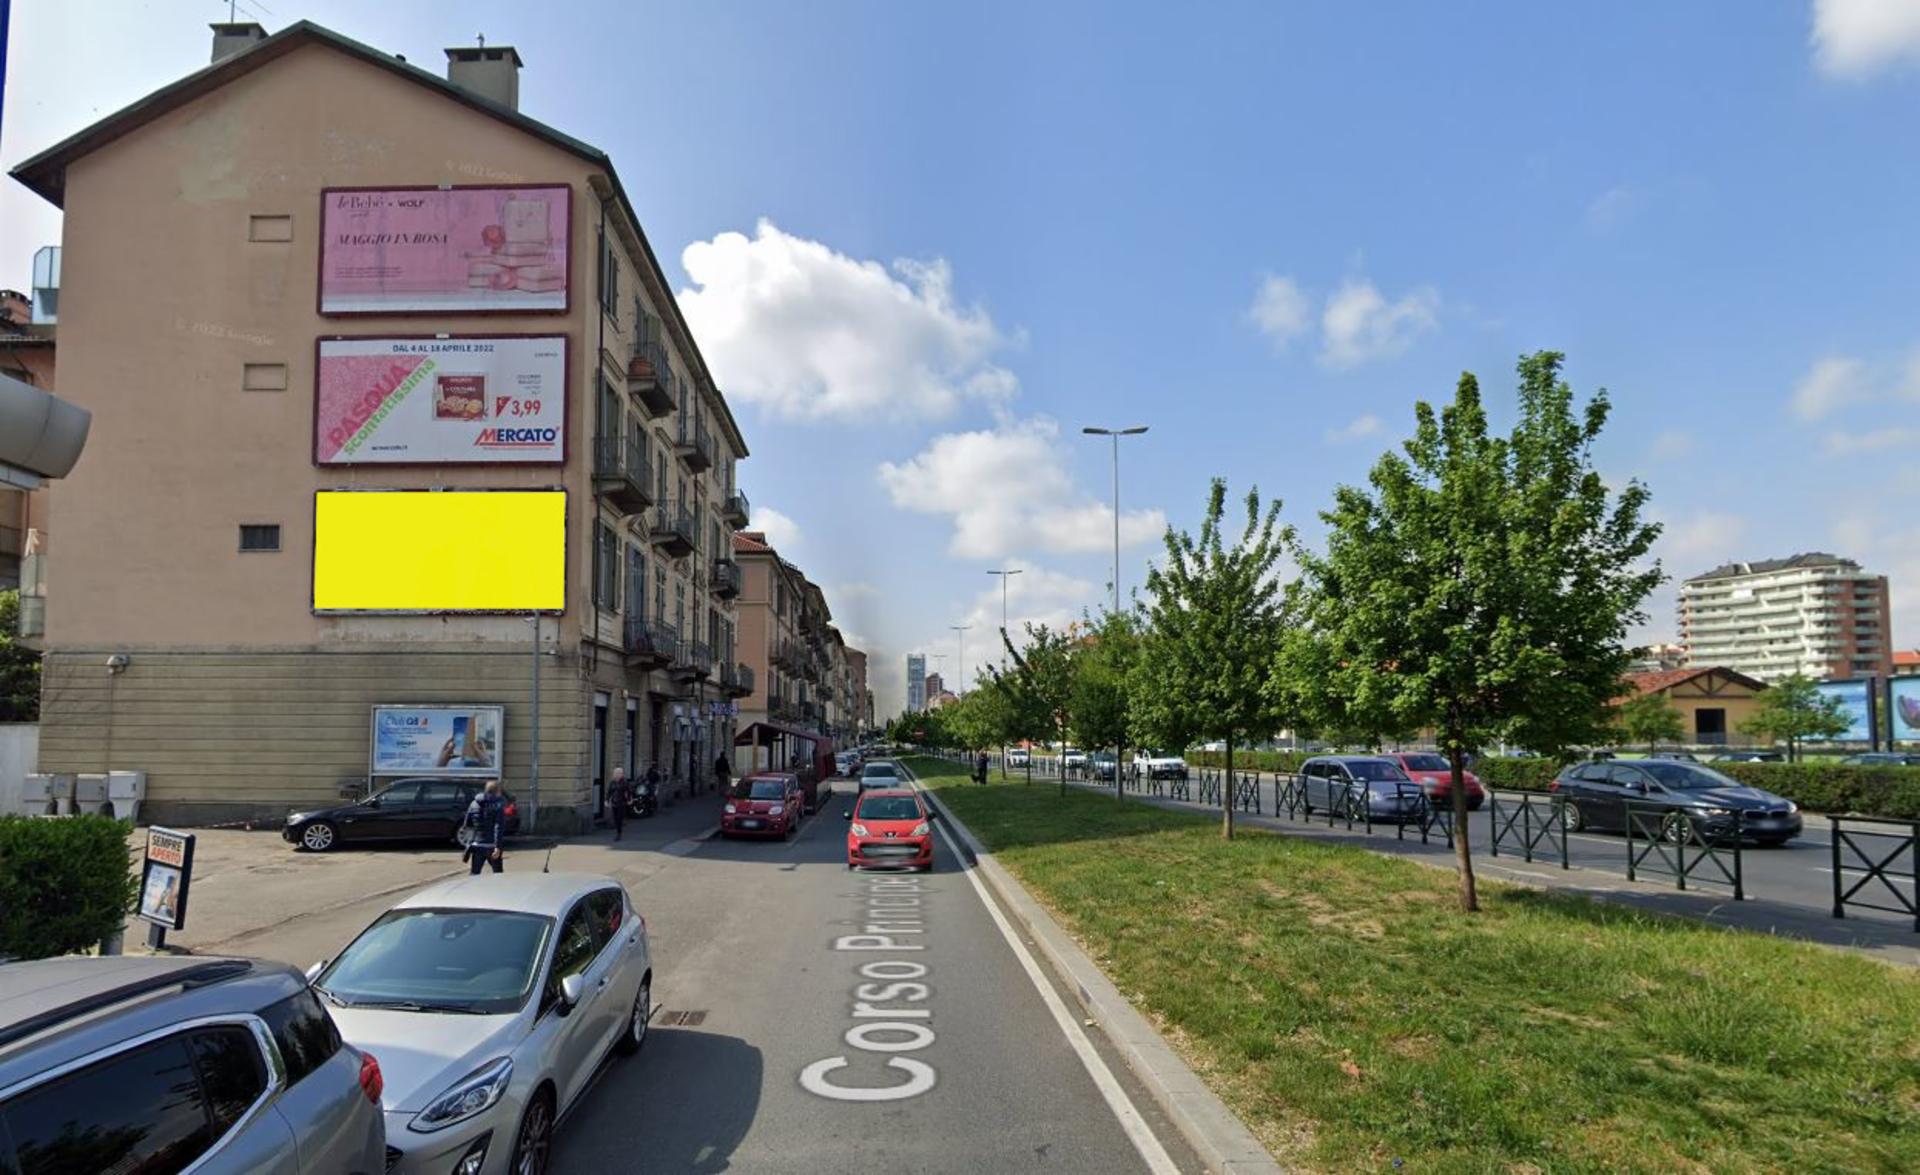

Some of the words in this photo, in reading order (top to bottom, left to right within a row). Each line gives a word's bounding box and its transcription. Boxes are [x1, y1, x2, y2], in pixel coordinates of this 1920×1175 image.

[398, 199, 425, 208] WOLF
[339, 233, 391, 246] MAGGIO
[394, 233, 409, 245] IN
[393, 344, 409, 353] DAL
[411, 344, 417, 352] 4
[418, 344, 428, 352] AL
[442, 344, 471, 352] APRILE
[473, 344, 495, 352] 2022
[326, 365, 412, 448] PASQUA
[344, 360, 436, 453] scontatissima
[511, 399, 542, 418] 3,99
[152, 834, 183, 852] SEMPRE
[150, 847, 181, 864] APERTO
